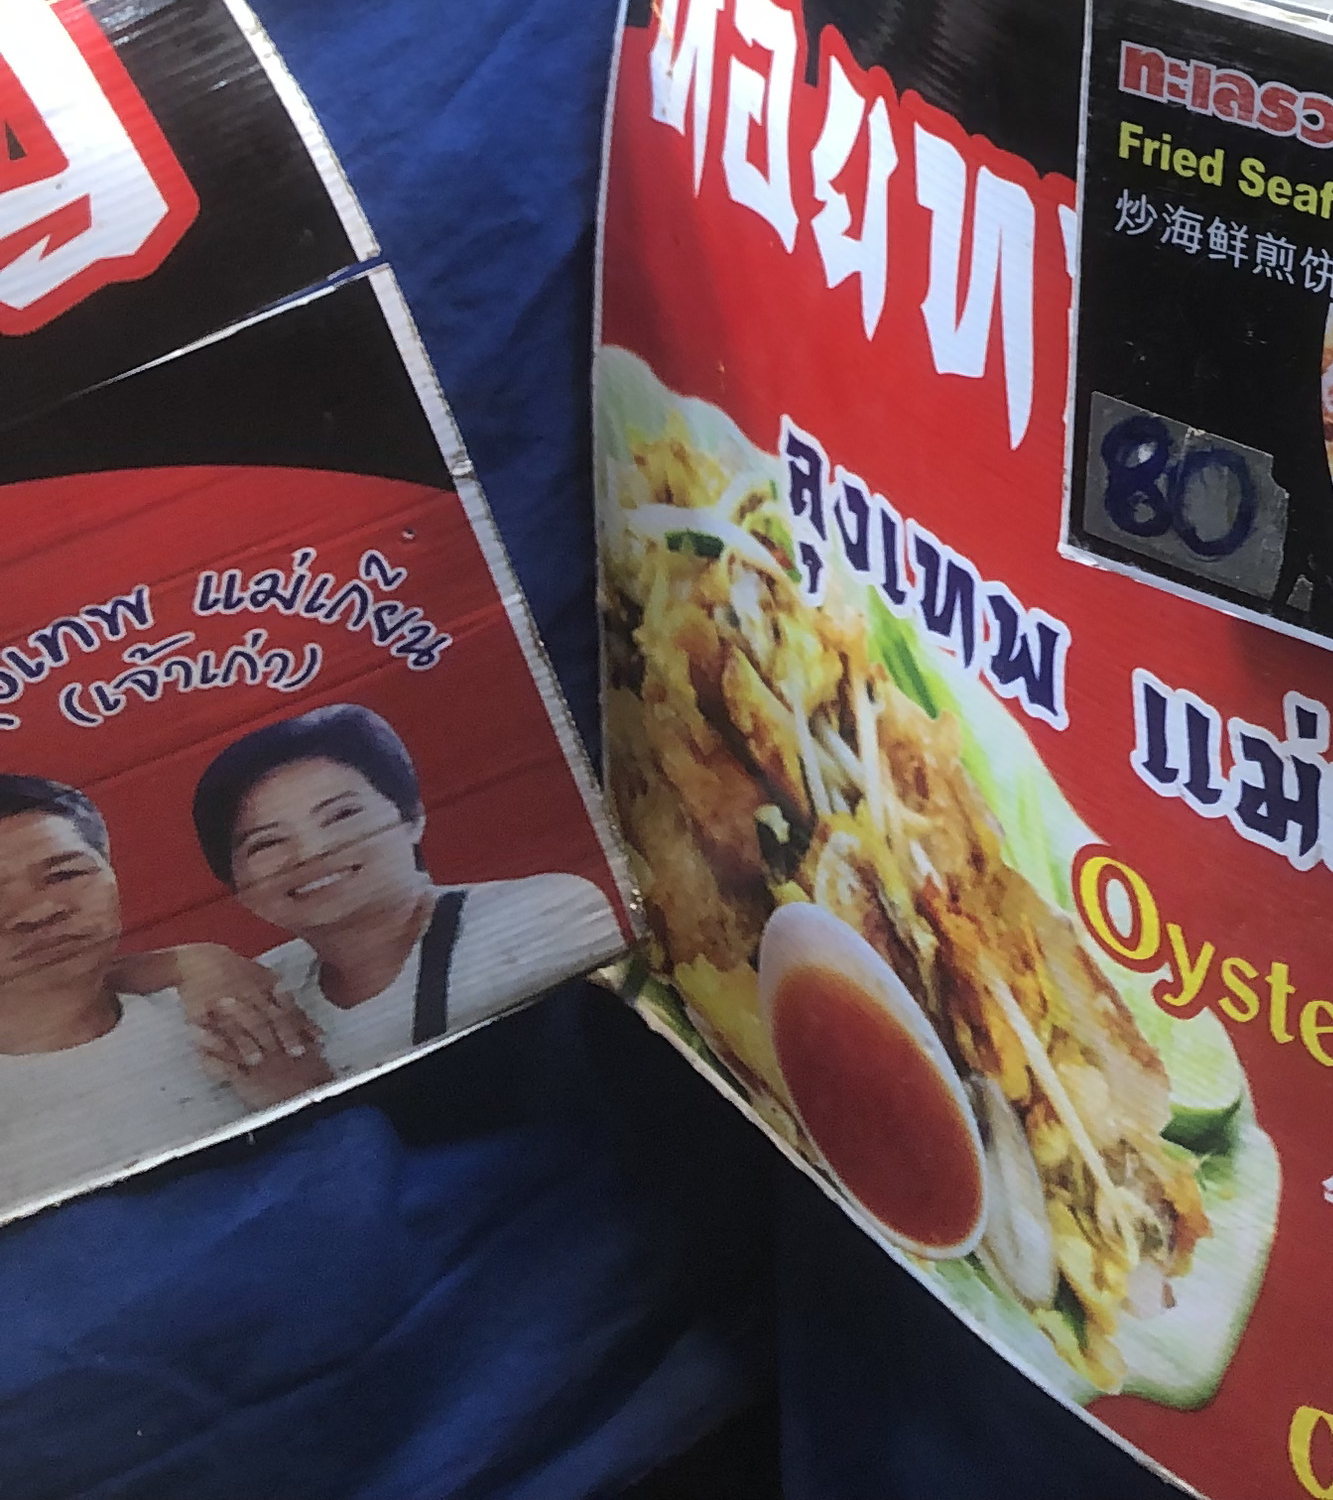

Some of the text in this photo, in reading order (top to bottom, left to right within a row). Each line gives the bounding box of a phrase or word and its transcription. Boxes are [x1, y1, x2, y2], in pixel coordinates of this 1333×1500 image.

[1118, 121, 1225, 187] Fried
[1098, 416, 1259, 558] 80
[783, 419, 1067, 723] ลุงเทพ
